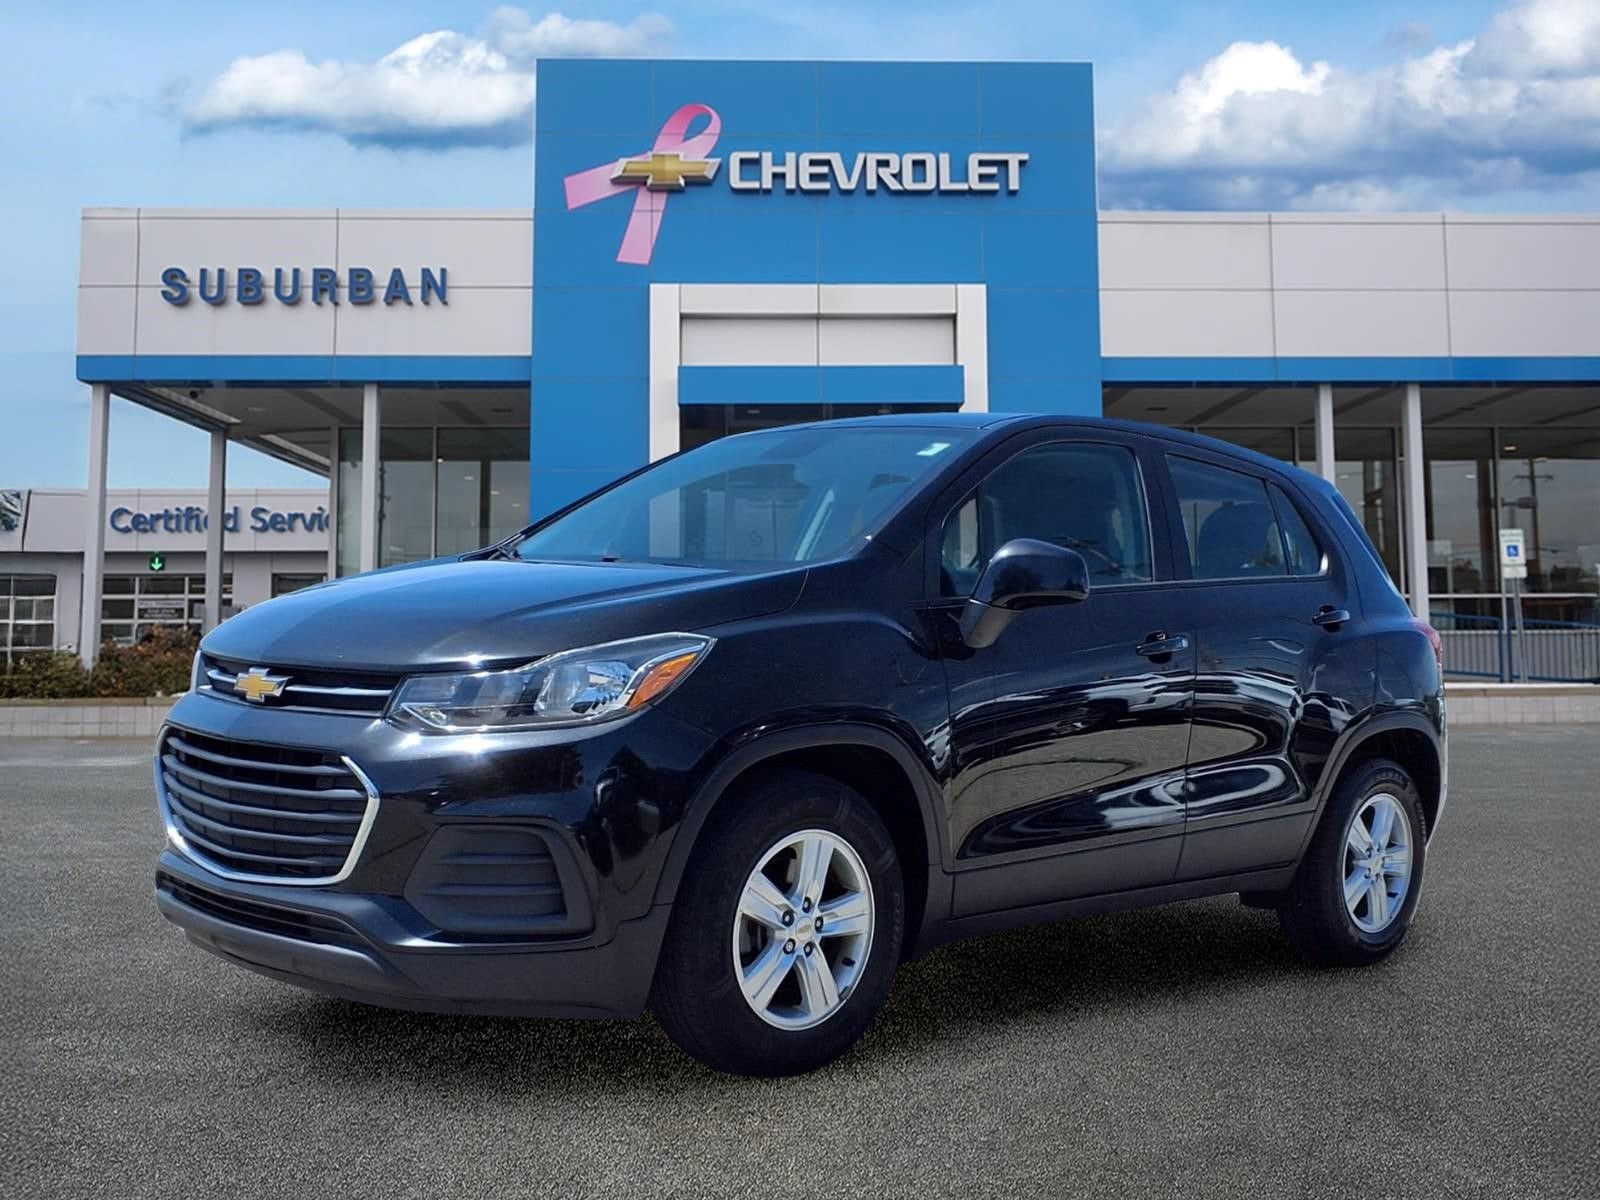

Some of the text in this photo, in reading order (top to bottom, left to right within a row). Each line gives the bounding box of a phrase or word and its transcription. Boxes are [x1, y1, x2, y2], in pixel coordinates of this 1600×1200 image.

[728, 151, 1030, 192] CHEVROLET
[160, 267, 449, 305] SUBURBAN
[109, 506, 240, 533] Certifid
